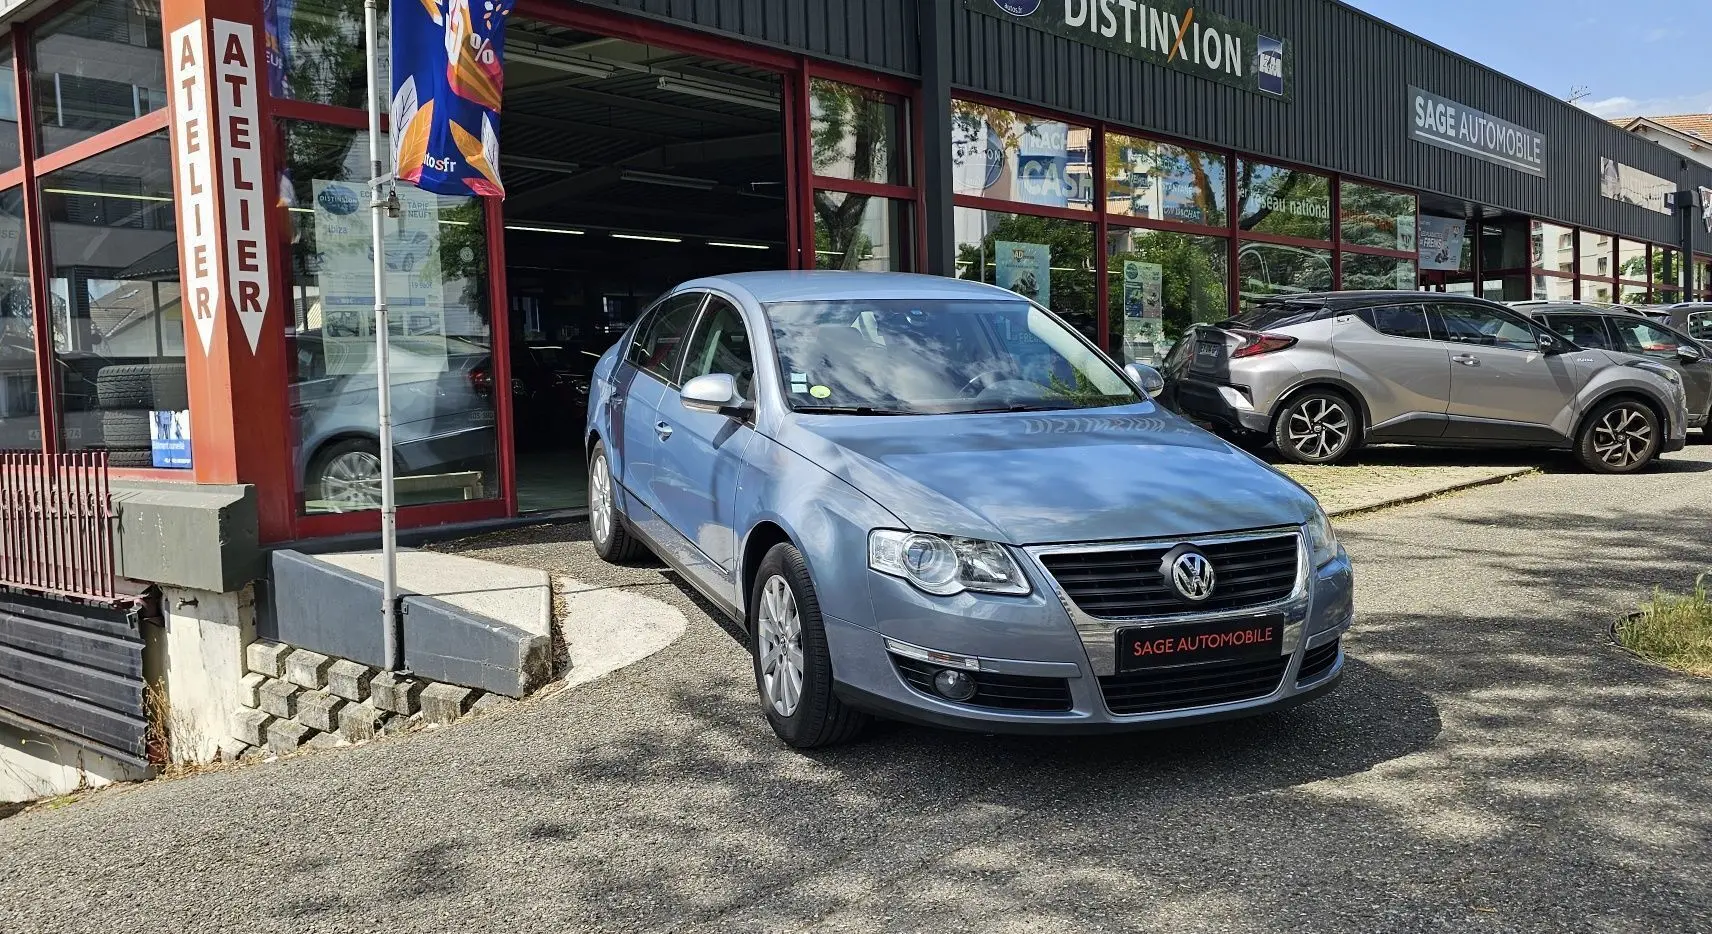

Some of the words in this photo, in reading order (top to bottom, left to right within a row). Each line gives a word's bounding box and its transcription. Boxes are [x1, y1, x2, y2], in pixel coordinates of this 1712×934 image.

[1415, 95, 1456, 137] SAGE
[1459, 111, 1541, 163] AUTOMOBILE
[180, 34, 212, 320] ATELIER
[222, 32, 263, 313] ATELIER
[1289, 198, 1330, 219] national
[1133, 638, 1174, 656] SAGE
[1177, 627, 1274, 652] AUTOMOBILE
